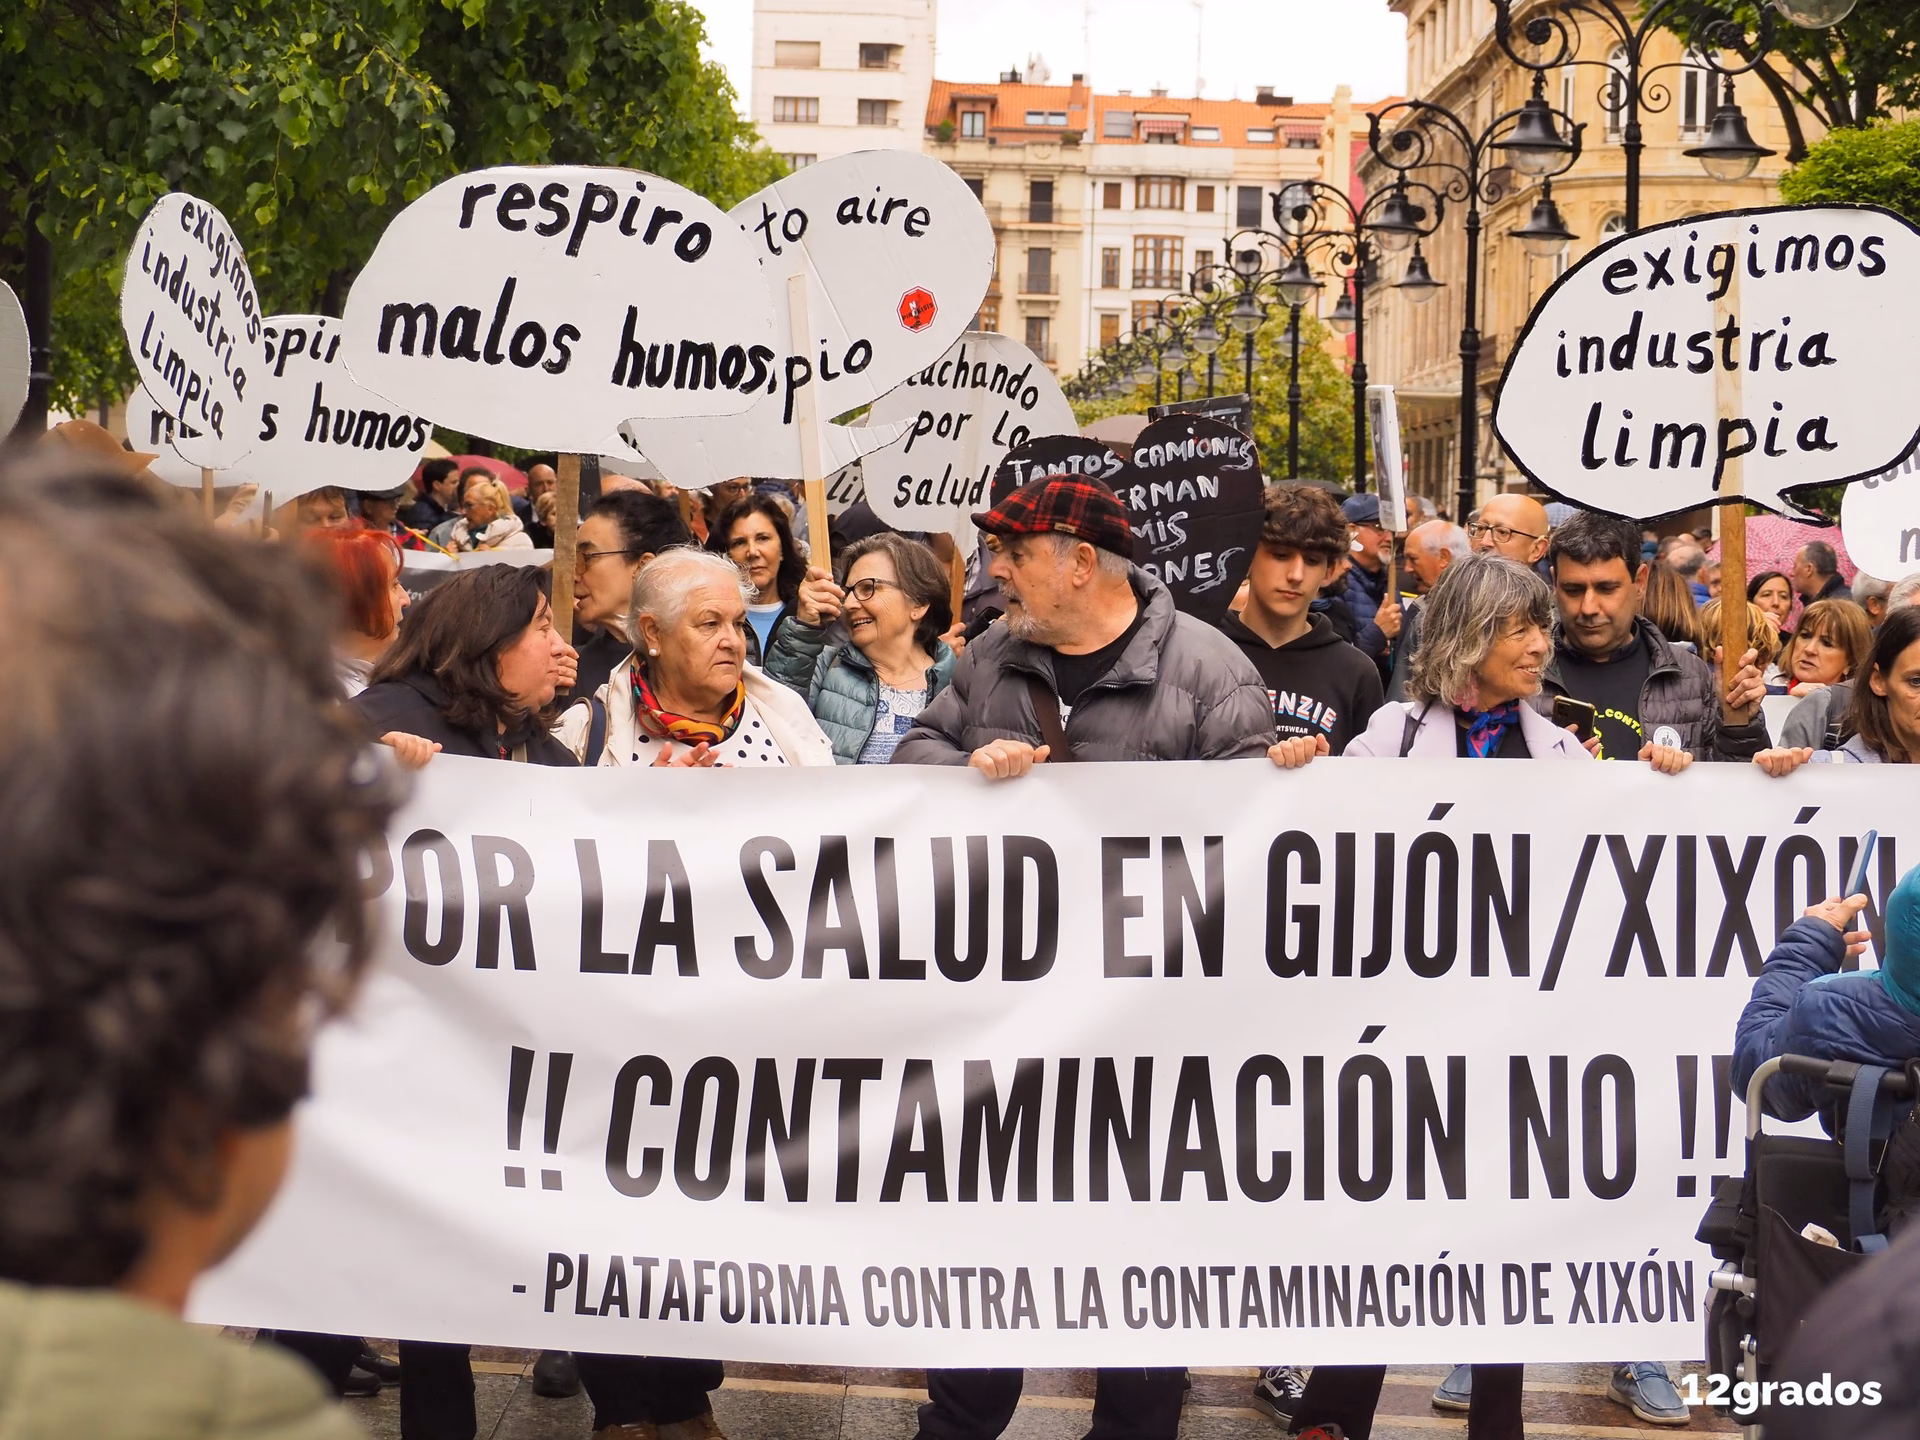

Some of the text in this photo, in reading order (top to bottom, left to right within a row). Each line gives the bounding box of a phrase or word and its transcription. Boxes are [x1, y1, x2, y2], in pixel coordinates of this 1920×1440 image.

[459, 180, 712, 263] respiro
[741, 185, 931, 256] to aire
[181, 200, 261, 344] exigimos
[1602, 223, 1887, 303] exigimos
[141, 227, 247, 402] industria
[377, 276, 582, 375] malos
[1556, 310, 1838, 379] industria
[140, 311, 224, 441] limpia
[304, 381, 432, 452] humos
[907, 343, 1039, 411] uchando
[904, 410, 973, 454] por
[1580, 400, 1839, 492] limpia
[893, 463, 991, 509] salud
[574, 838, 699, 977] LA
[734, 835, 1060, 983] SALUD
[1100, 836, 1225, 979] EN
[504, 1045, 574, 1191] !!
[605, 1025, 1468, 1203] CONTAMINACIÓN
[1508, 1053, 1637, 1201] NO
[543, 1252, 850, 1327] PLATAFORMA
[862, 1266, 1041, 1331] CONTRA
[1053, 1266, 1109, 1330] LA
[1122, 1250, 1486, 1330] CONTAMINACIÓN
[1501, 1262, 1554, 1325] DE
[1565, 1247, 1696, 1324] XIXÓN
